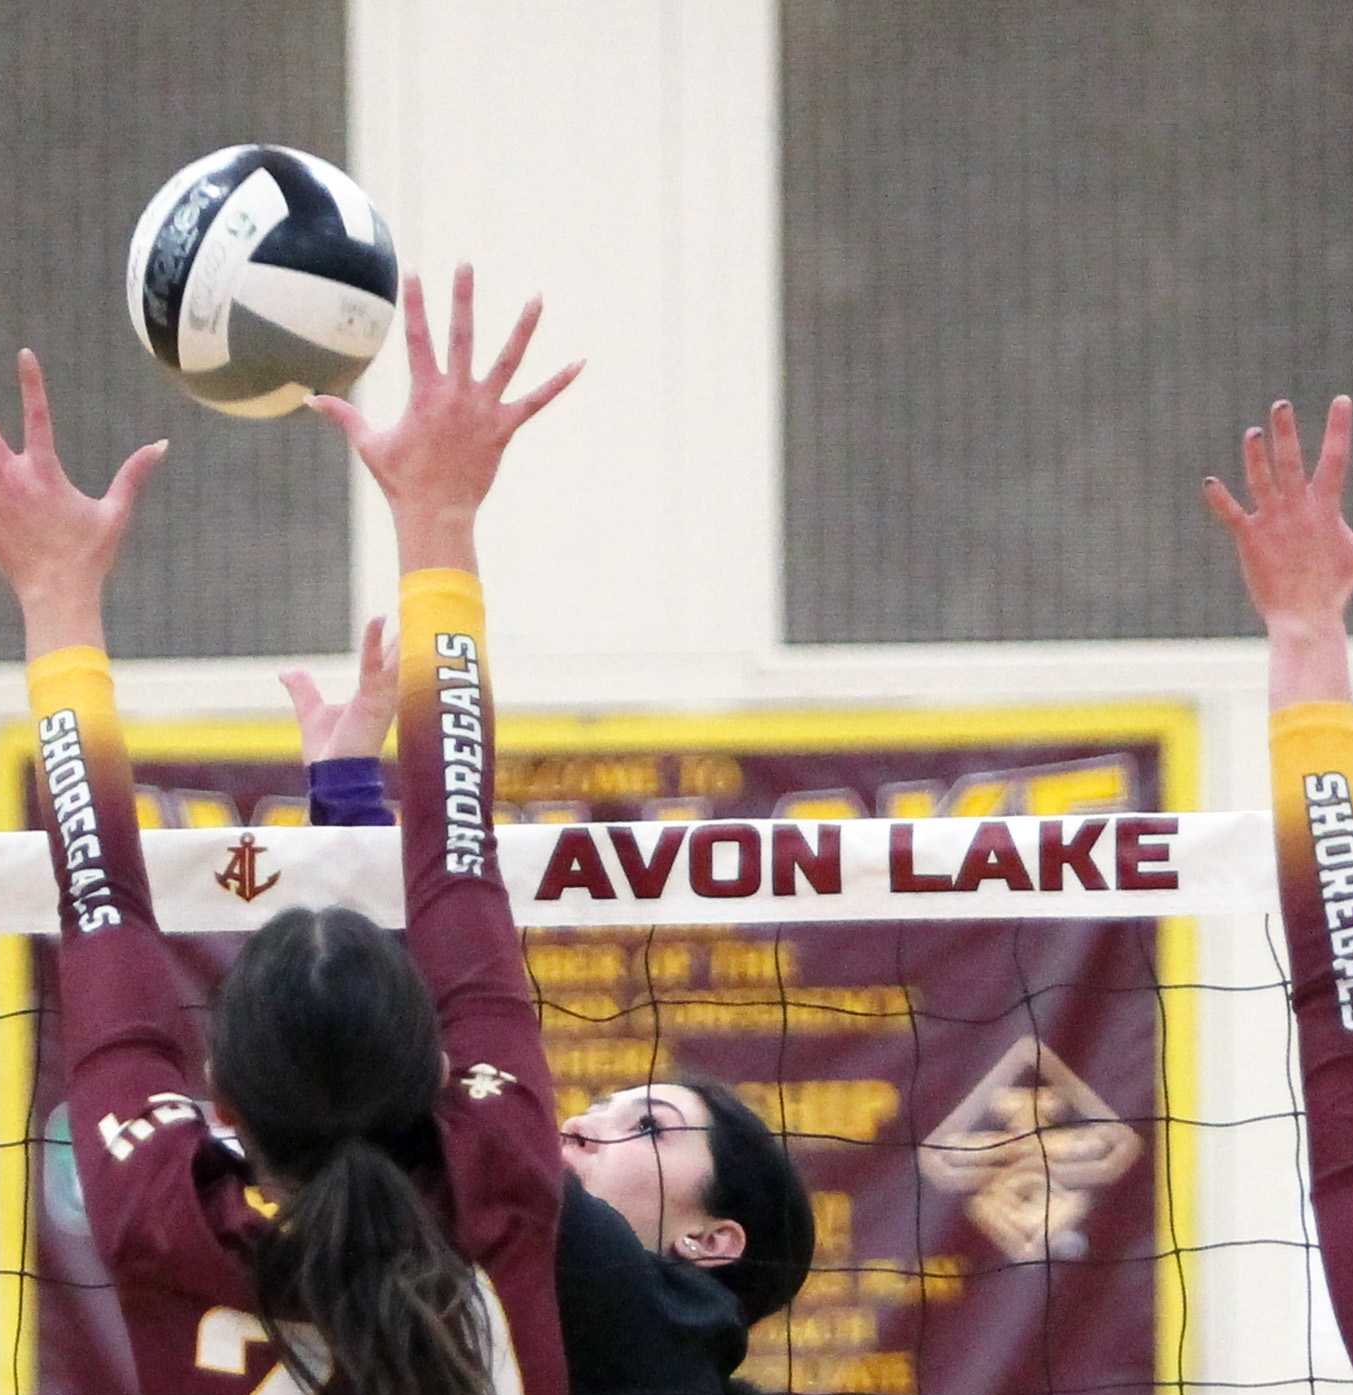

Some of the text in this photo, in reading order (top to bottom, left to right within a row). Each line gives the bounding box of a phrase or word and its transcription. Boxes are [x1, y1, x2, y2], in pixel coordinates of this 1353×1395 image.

[39, 708, 122, 934] SHOREGALS
[436, 633, 485, 878] SHOREGALS
[534, 817, 1179, 900] AVON LAKE
